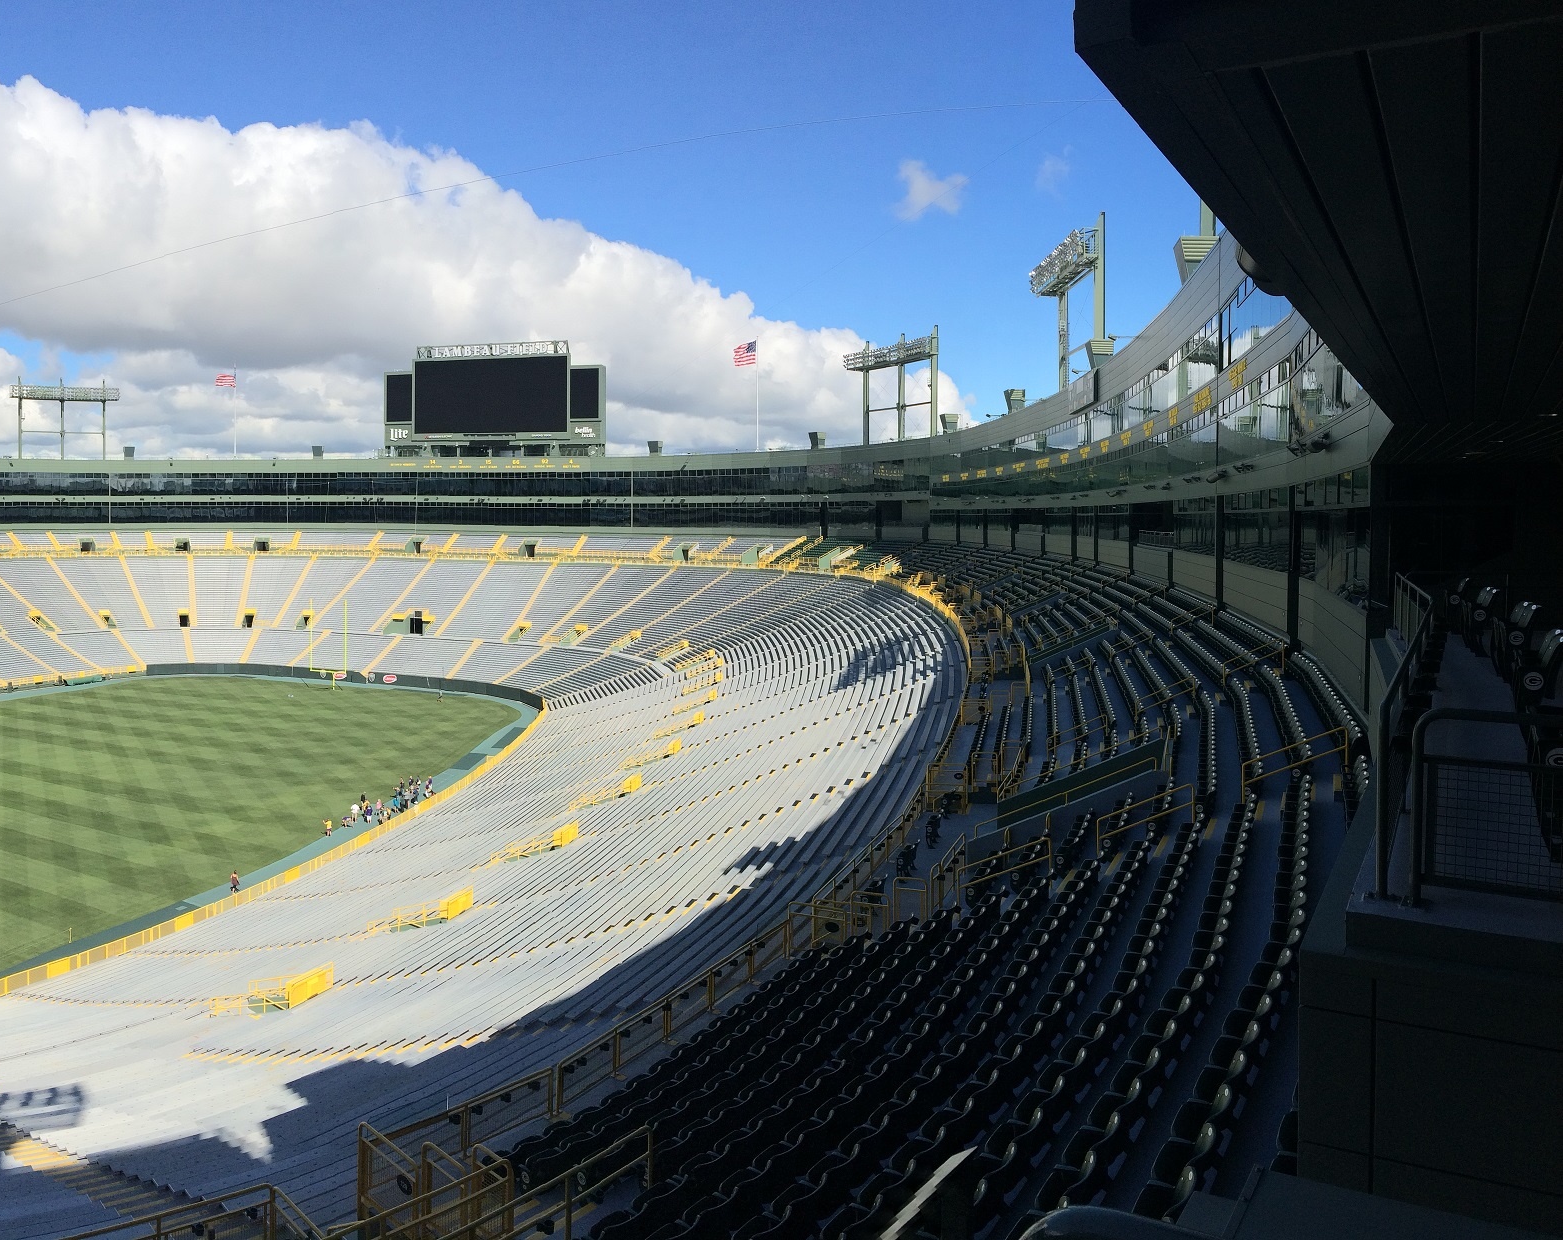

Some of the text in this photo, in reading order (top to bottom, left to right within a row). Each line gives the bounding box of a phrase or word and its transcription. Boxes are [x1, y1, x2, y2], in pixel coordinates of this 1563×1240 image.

[434, 342, 547, 358] LAMBEAU FIELD
[390, 428, 408, 441] Lite
